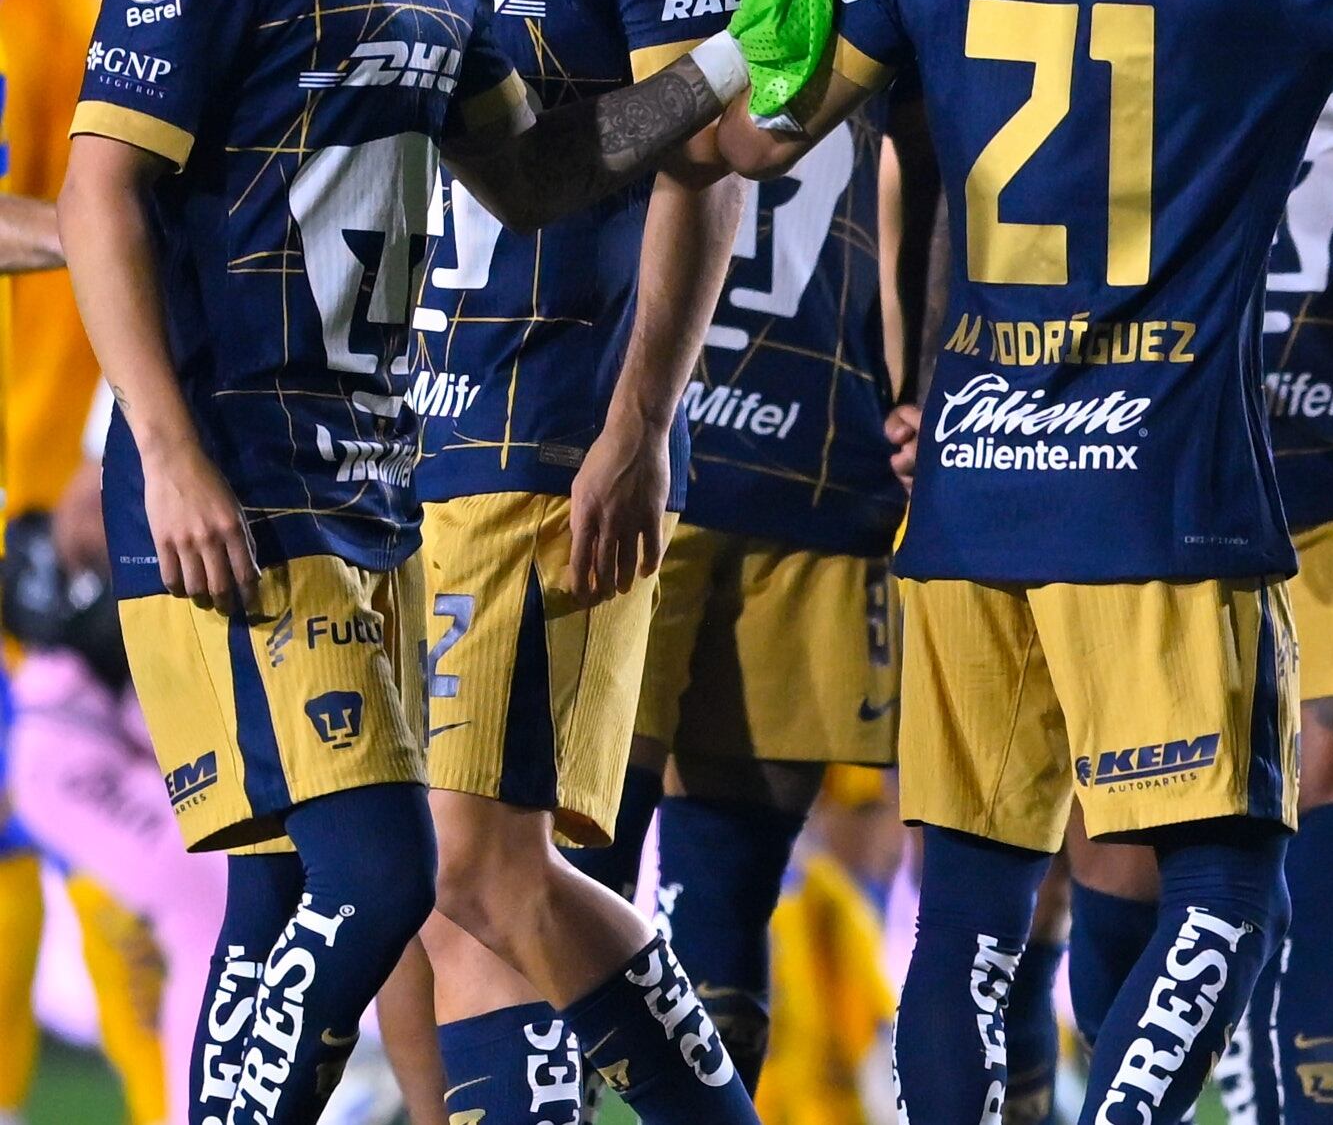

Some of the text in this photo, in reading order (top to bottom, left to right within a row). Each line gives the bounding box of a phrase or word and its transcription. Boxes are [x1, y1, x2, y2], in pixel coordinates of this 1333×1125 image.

[103, 46, 171, 83] GNP
[98, 75, 165, 99] SEGUROS
[944, 312, 982, 356] M.
[686, 380, 801, 439] Mifel
[934, 373, 1151, 443] Caliente
[940, 436, 1139, 471] caliente.mx
[306, 615, 383, 650] Futu
[1097, 732, 1221, 775] KEM
[1107, 772, 1198, 794] AUTOPARTES
